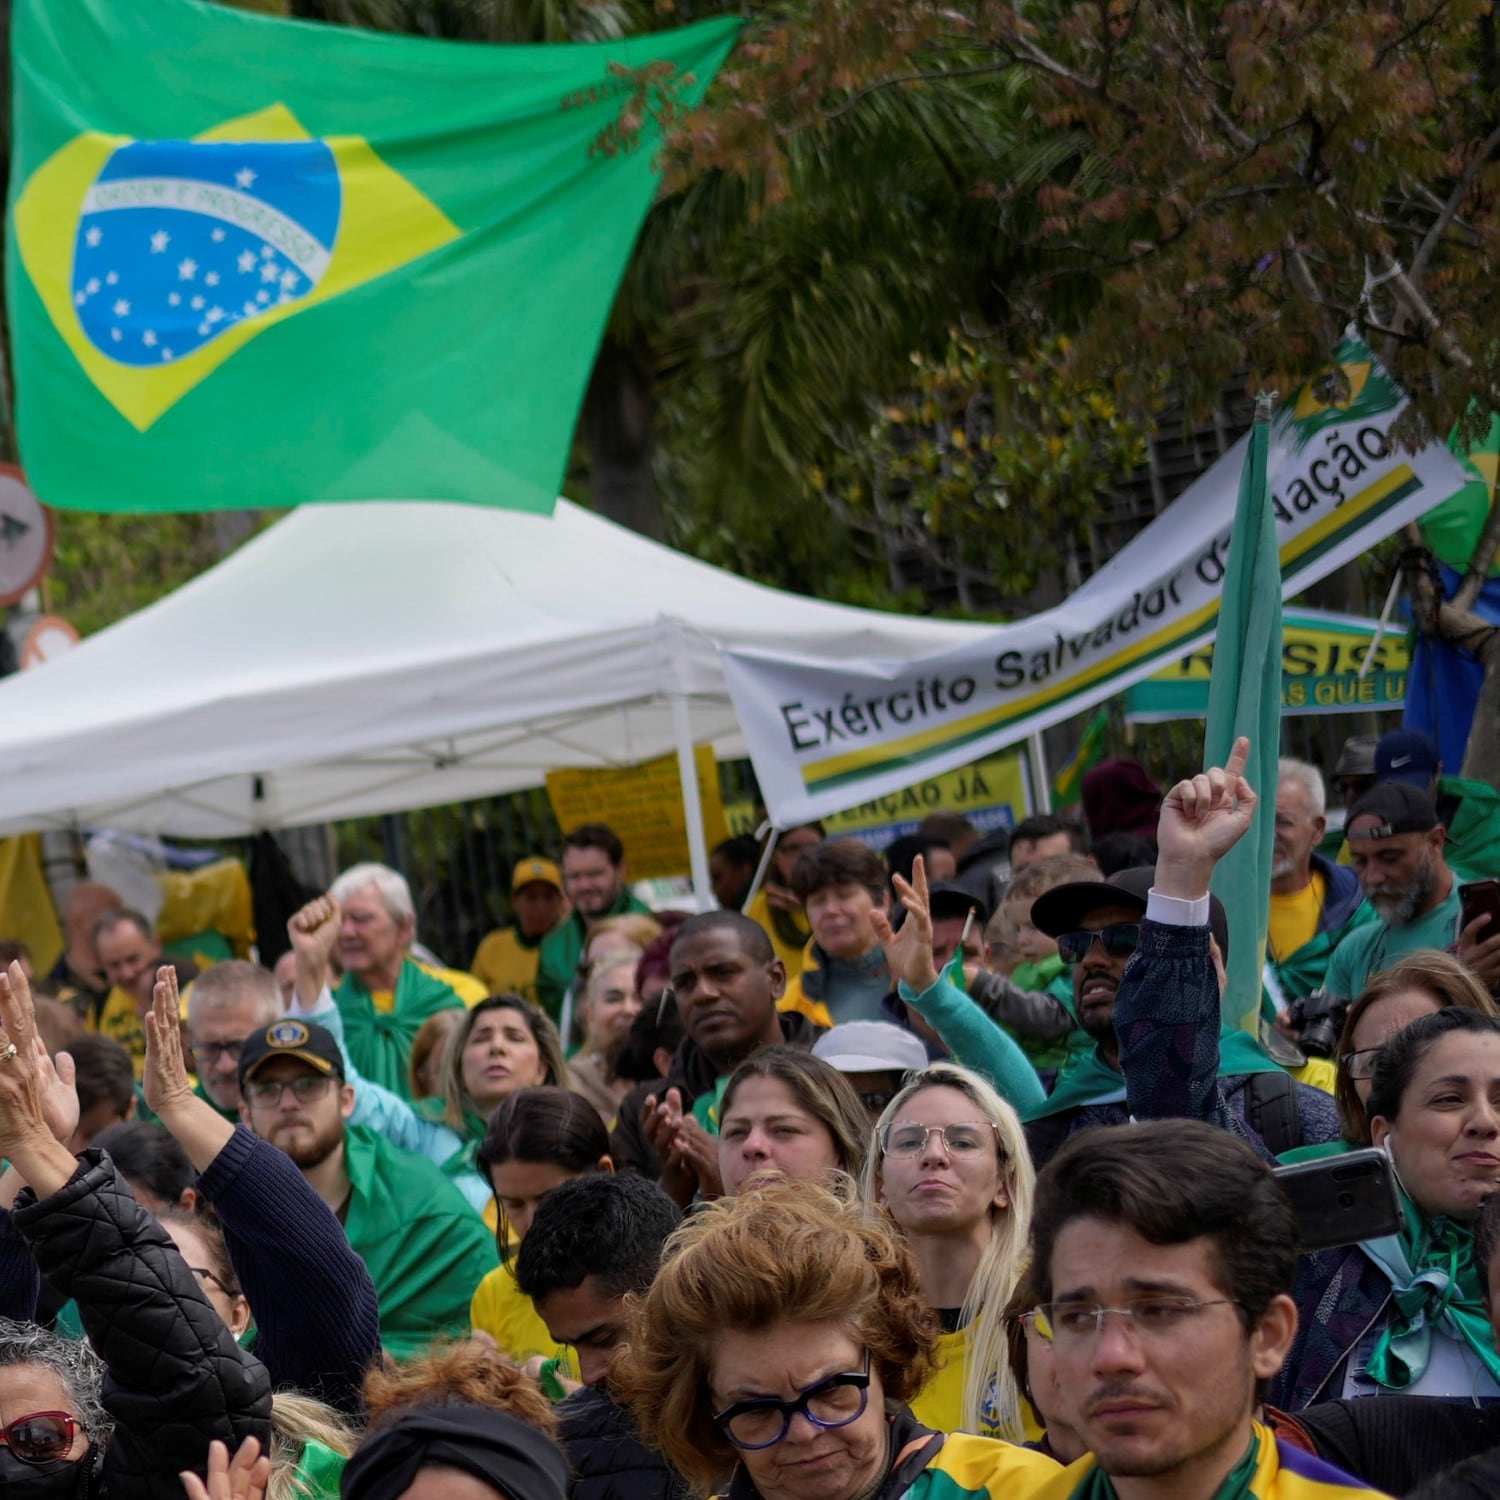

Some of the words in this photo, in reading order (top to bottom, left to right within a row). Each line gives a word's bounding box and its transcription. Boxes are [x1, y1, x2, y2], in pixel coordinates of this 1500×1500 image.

[780, 675, 977, 751] Exército
[994, 573, 1185, 690] Salvador
[1195, 535, 1231, 584] d
[1315, 680, 1376, 705] QUE
